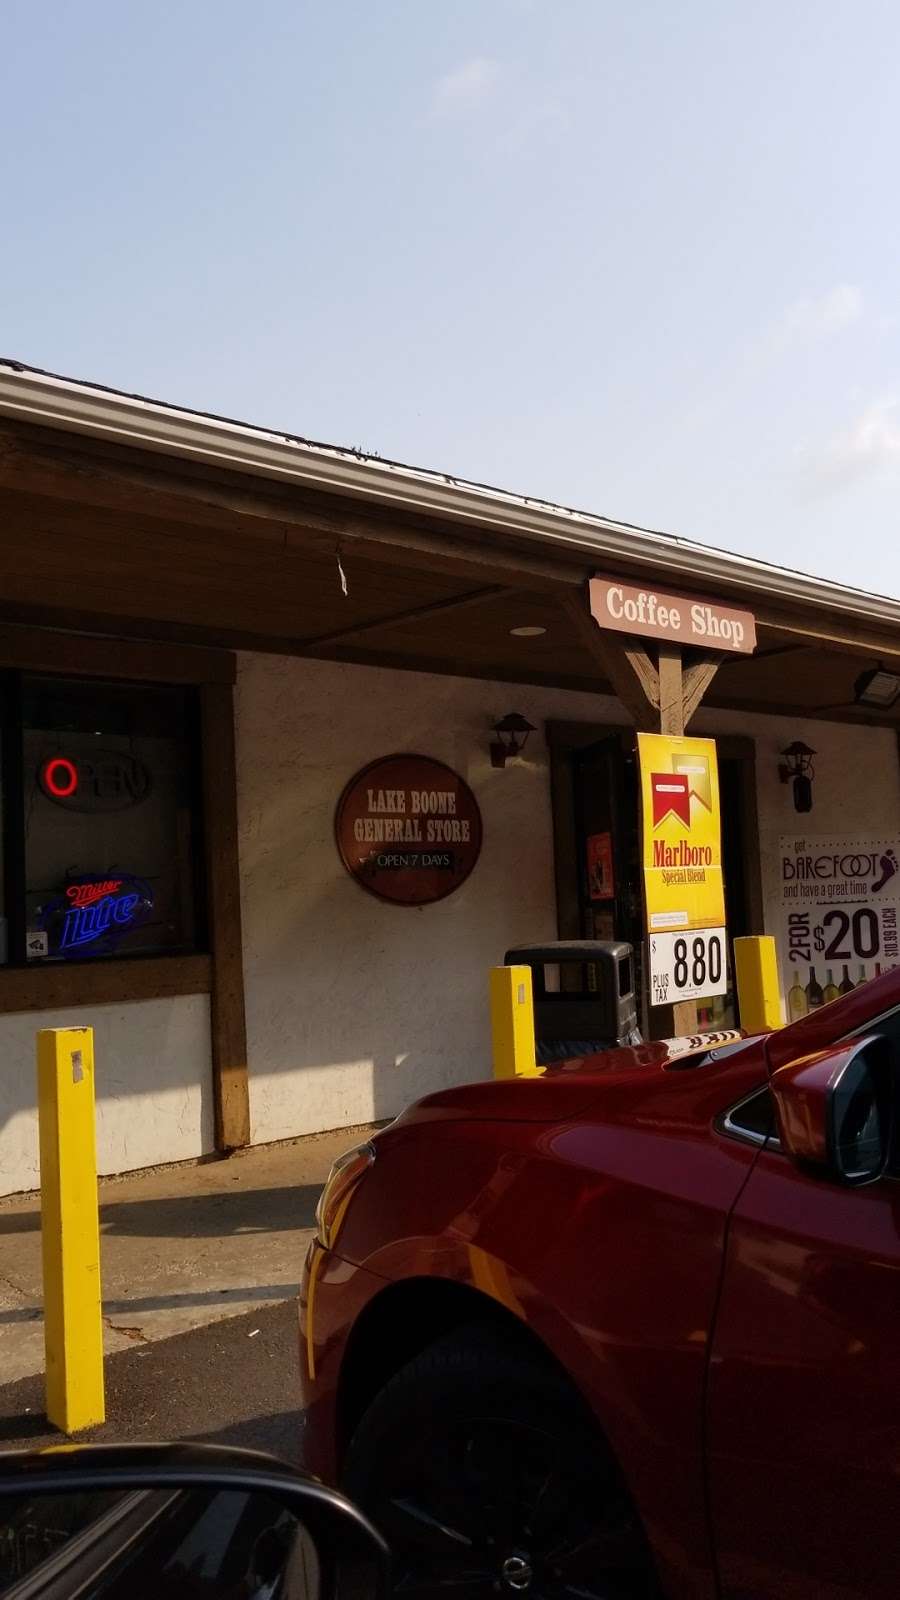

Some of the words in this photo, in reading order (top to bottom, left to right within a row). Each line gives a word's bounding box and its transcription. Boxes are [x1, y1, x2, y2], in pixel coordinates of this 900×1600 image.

[606, 586, 681, 630] Coffee
[690, 604, 744, 648] Shop
[367, 789, 406, 814] LAKE
[410, 790, 456, 815] BOONE
[353, 818, 422, 842] GENERAL
[426, 820, 470, 842] STORE
[377, 854, 409, 867] OPEN
[411, 854, 419, 866] 7
[421, 854, 449, 866] DAYS
[653, 840, 712, 868] Marlboro
[661, 868, 686, 887] Special
[687, 868, 706, 882] Blend
[783, 853, 879, 880] BAREFOOT
[783, 883, 798, 898] and
[800, 881, 819, 897] have
[821, 884, 826, 897] a
[827, 880, 849, 898] great
[850, 880, 868, 895] time
[61, 893, 139, 950] Lite
[882, 907, 897, 929] EACH
[813, 908, 880, 960] $20
[883, 929, 899, 958] $10.99
[651, 940, 657, 954] $
[653, 973, 669, 989] PLUS
[655, 988, 668, 1002] TAX
